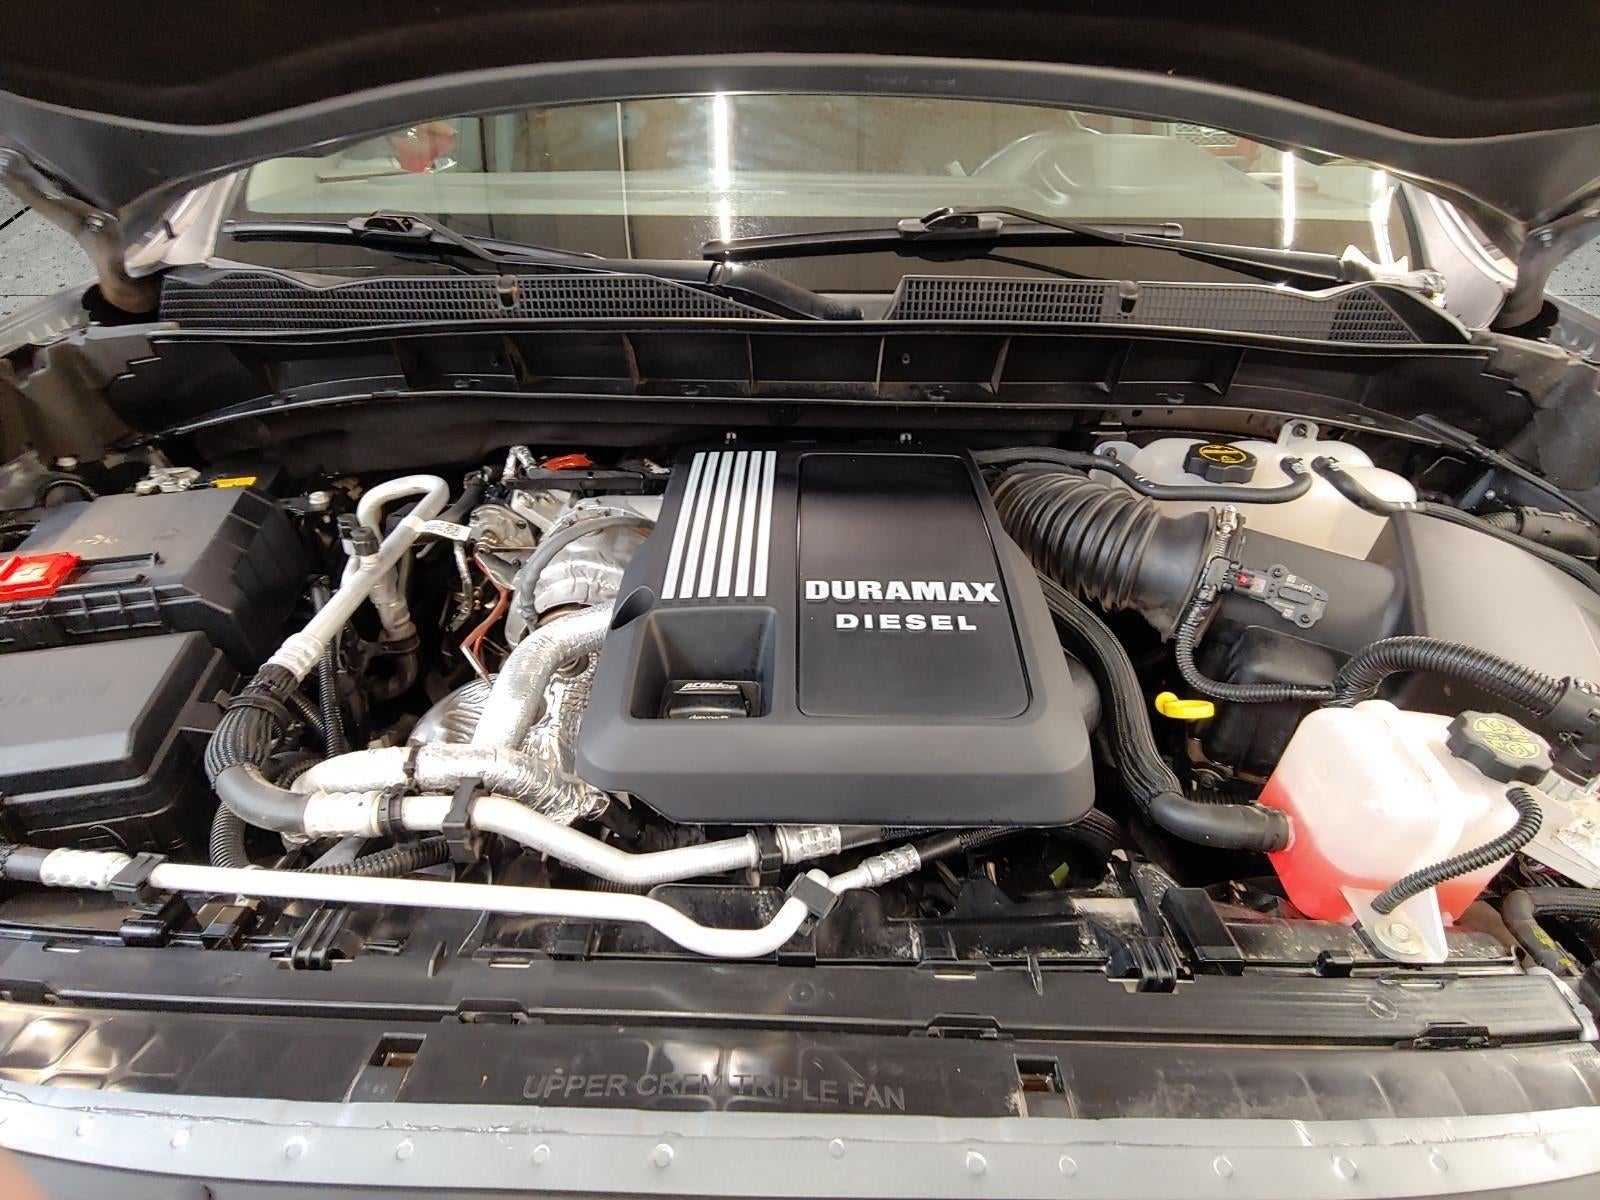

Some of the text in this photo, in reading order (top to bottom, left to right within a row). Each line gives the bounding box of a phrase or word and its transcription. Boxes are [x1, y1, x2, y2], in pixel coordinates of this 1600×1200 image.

[805, 580, 1000, 603] DURAMAX
[836, 614, 977, 631] DIESEL
[681, 682, 738, 691] ACDelco
[523, 1074, 628, 1099] UPPER
[733, 1074, 840, 1104] TRIPLE
[848, 1081, 906, 1111] FAN
